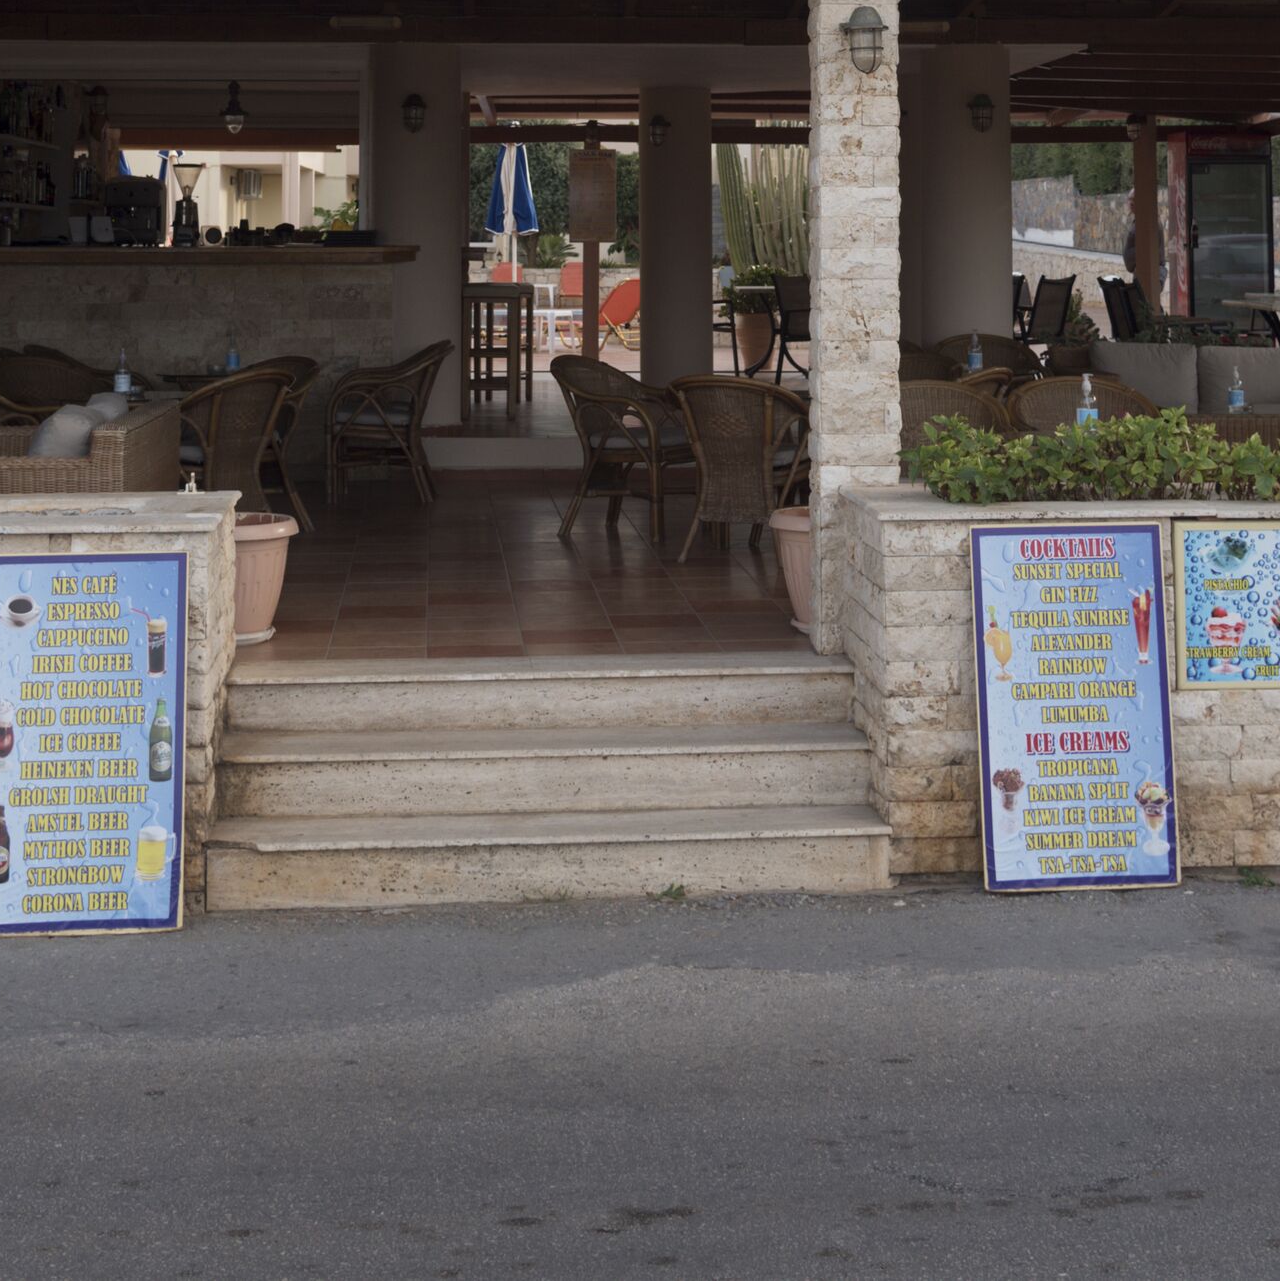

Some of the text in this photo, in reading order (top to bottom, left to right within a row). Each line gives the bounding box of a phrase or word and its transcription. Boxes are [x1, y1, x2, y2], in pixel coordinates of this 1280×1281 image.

[1020, 537, 1116, 561] COCKTAILS
[1013, 561, 1122, 580] SUNSET SPECIAL
[52, 573, 117, 595] NES CAFÉ
[1203, 579, 1249, 590] PISTACHIO
[1040, 586, 1098, 604] GIN FIZZ
[47, 601, 120, 621] ESPRESSO
[1011, 610, 1129, 629] TEQUILA SUNRISE
[37, 627, 128, 647] CAPPUCCINO
[1031, 633, 1112, 651] ALEXANDER
[1185, 646, 1271, 658] STRAWBERRY CREAM
[32, 654, 132, 674] IRISH COFFEE
[1039, 658, 1107, 675] RAINBOW
[1255, 665, 1280, 677] FRUIT
[21, 679, 143, 700] HOT CHOCOLATE
[1011, 681, 1137, 700] CAMPARI ORANGE
[16, 705, 145, 727] COLD CHOCOLATE
[1042, 705, 1109, 724] LUMUMBA
[39, 732, 121, 753] ICE COFFEE
[1025, 730, 1130, 755] ICE CREAMS
[20, 759, 138, 780] HEINEKEN BEER
[1037, 758, 1119, 778] TROPICANA
[9, 785, 148, 807] GROLSH DRAUGHT
[1028, 782, 1129, 802] BANANA SPLIT
[27, 812, 128, 833] AMSTEL BEER
[1023, 806, 1136, 827] KIWI ICE CREAM
[23, 839, 130, 860] MYTHOS BEER
[1026, 830, 1137, 851] SUMMER DREAM
[1039, 854, 1128, 874] TSA-TSA-TSA
[27, 865, 125, 887] STRONGBOW
[22, 892, 128, 914] CORONA BEER
